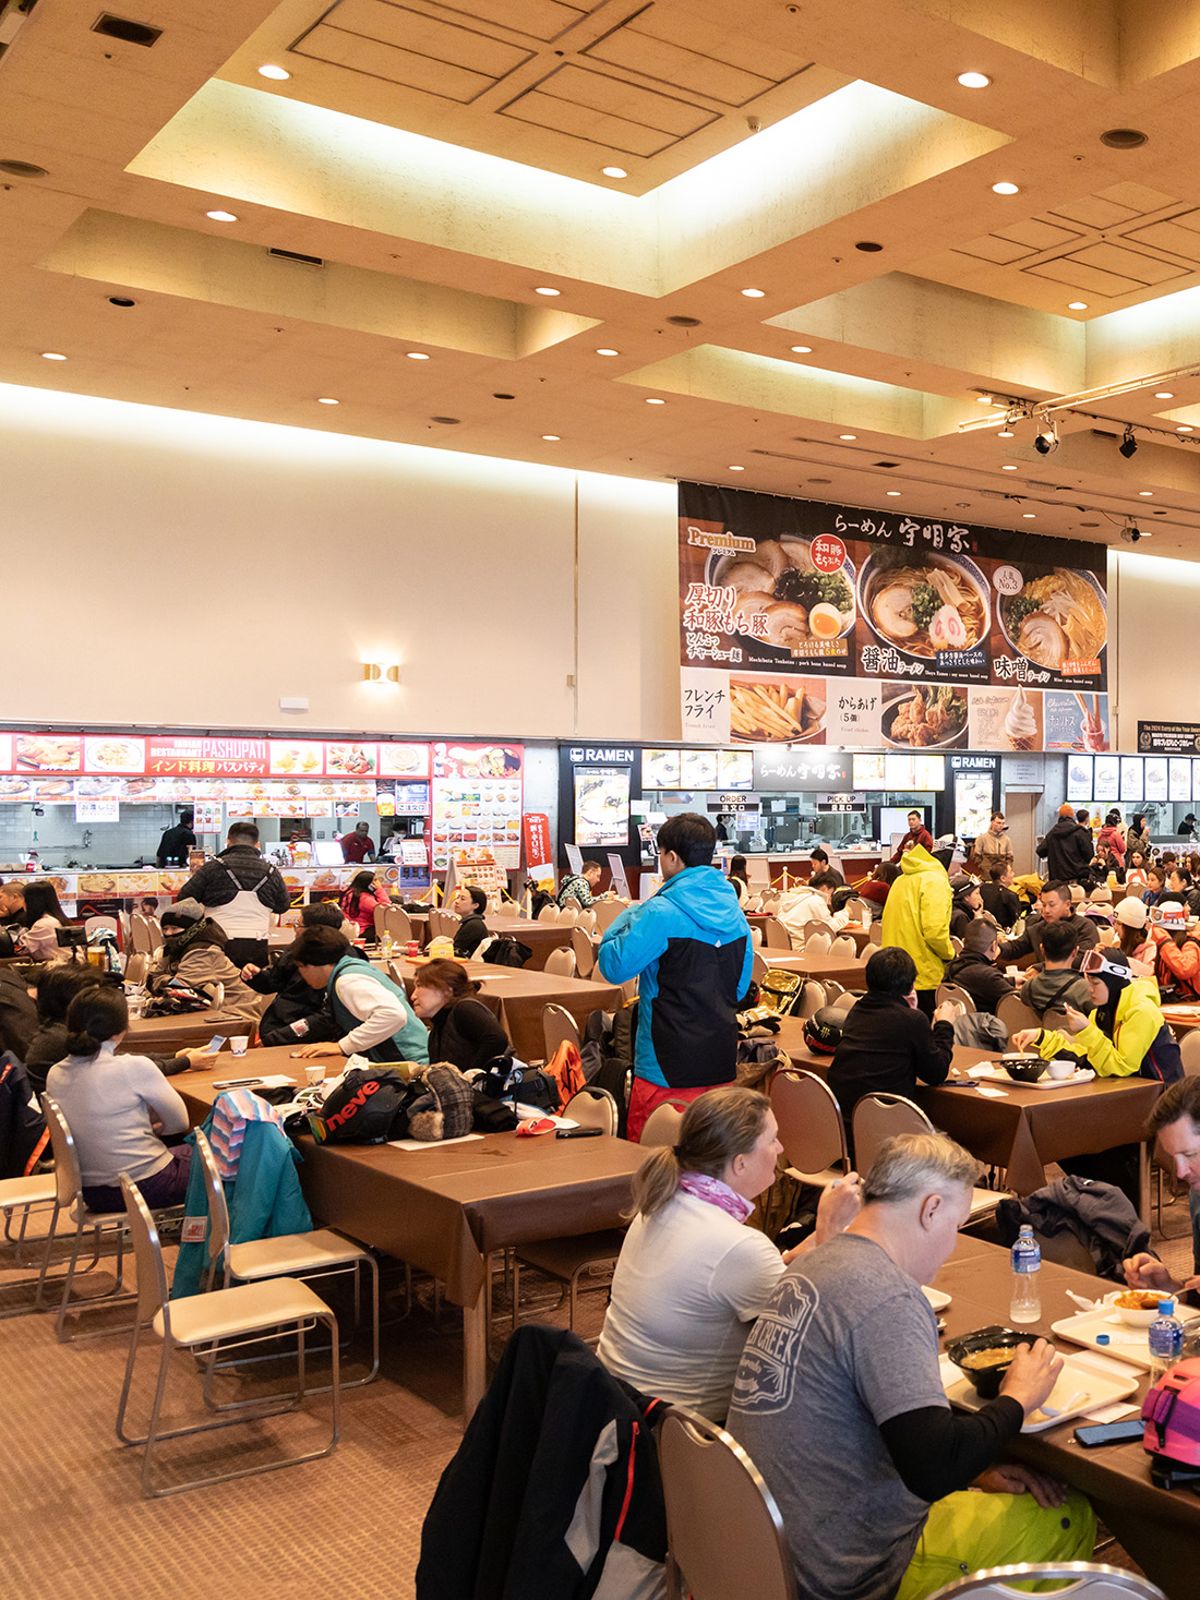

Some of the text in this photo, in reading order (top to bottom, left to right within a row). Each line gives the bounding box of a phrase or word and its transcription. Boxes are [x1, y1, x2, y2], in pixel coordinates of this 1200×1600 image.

[835, 514, 892, 538] らーめん
[687, 527, 756, 552] Premium
[815, 539, 841, 556] 和豚
[685, 583, 737, 609] 厚切り
[683, 607, 770, 637] 和豚もち豚
[861, 645, 925, 675] 醤油ラーメン
[993, 655, 1051, 683] 味噌ラーメン
[684, 689, 727, 704] フレンチ
[838, 695, 878, 711] からあげ
[684, 703, 716, 719] フライ
[202, 739, 266, 759] PASHUPATI
[585, 748, 634, 762] RAMEN
[151, 760, 215, 774] インド料理
[760, 763, 797, 778] らーめん
[962, 757, 996, 769] RAMEN
[720, 795, 747, 803] ORDER
[827, 795, 856, 803] PICK UP
[721, 804, 746, 812] 注文口
[326, 1081, 380, 1132] neve
[757, 1320, 799, 1365] CREEK
